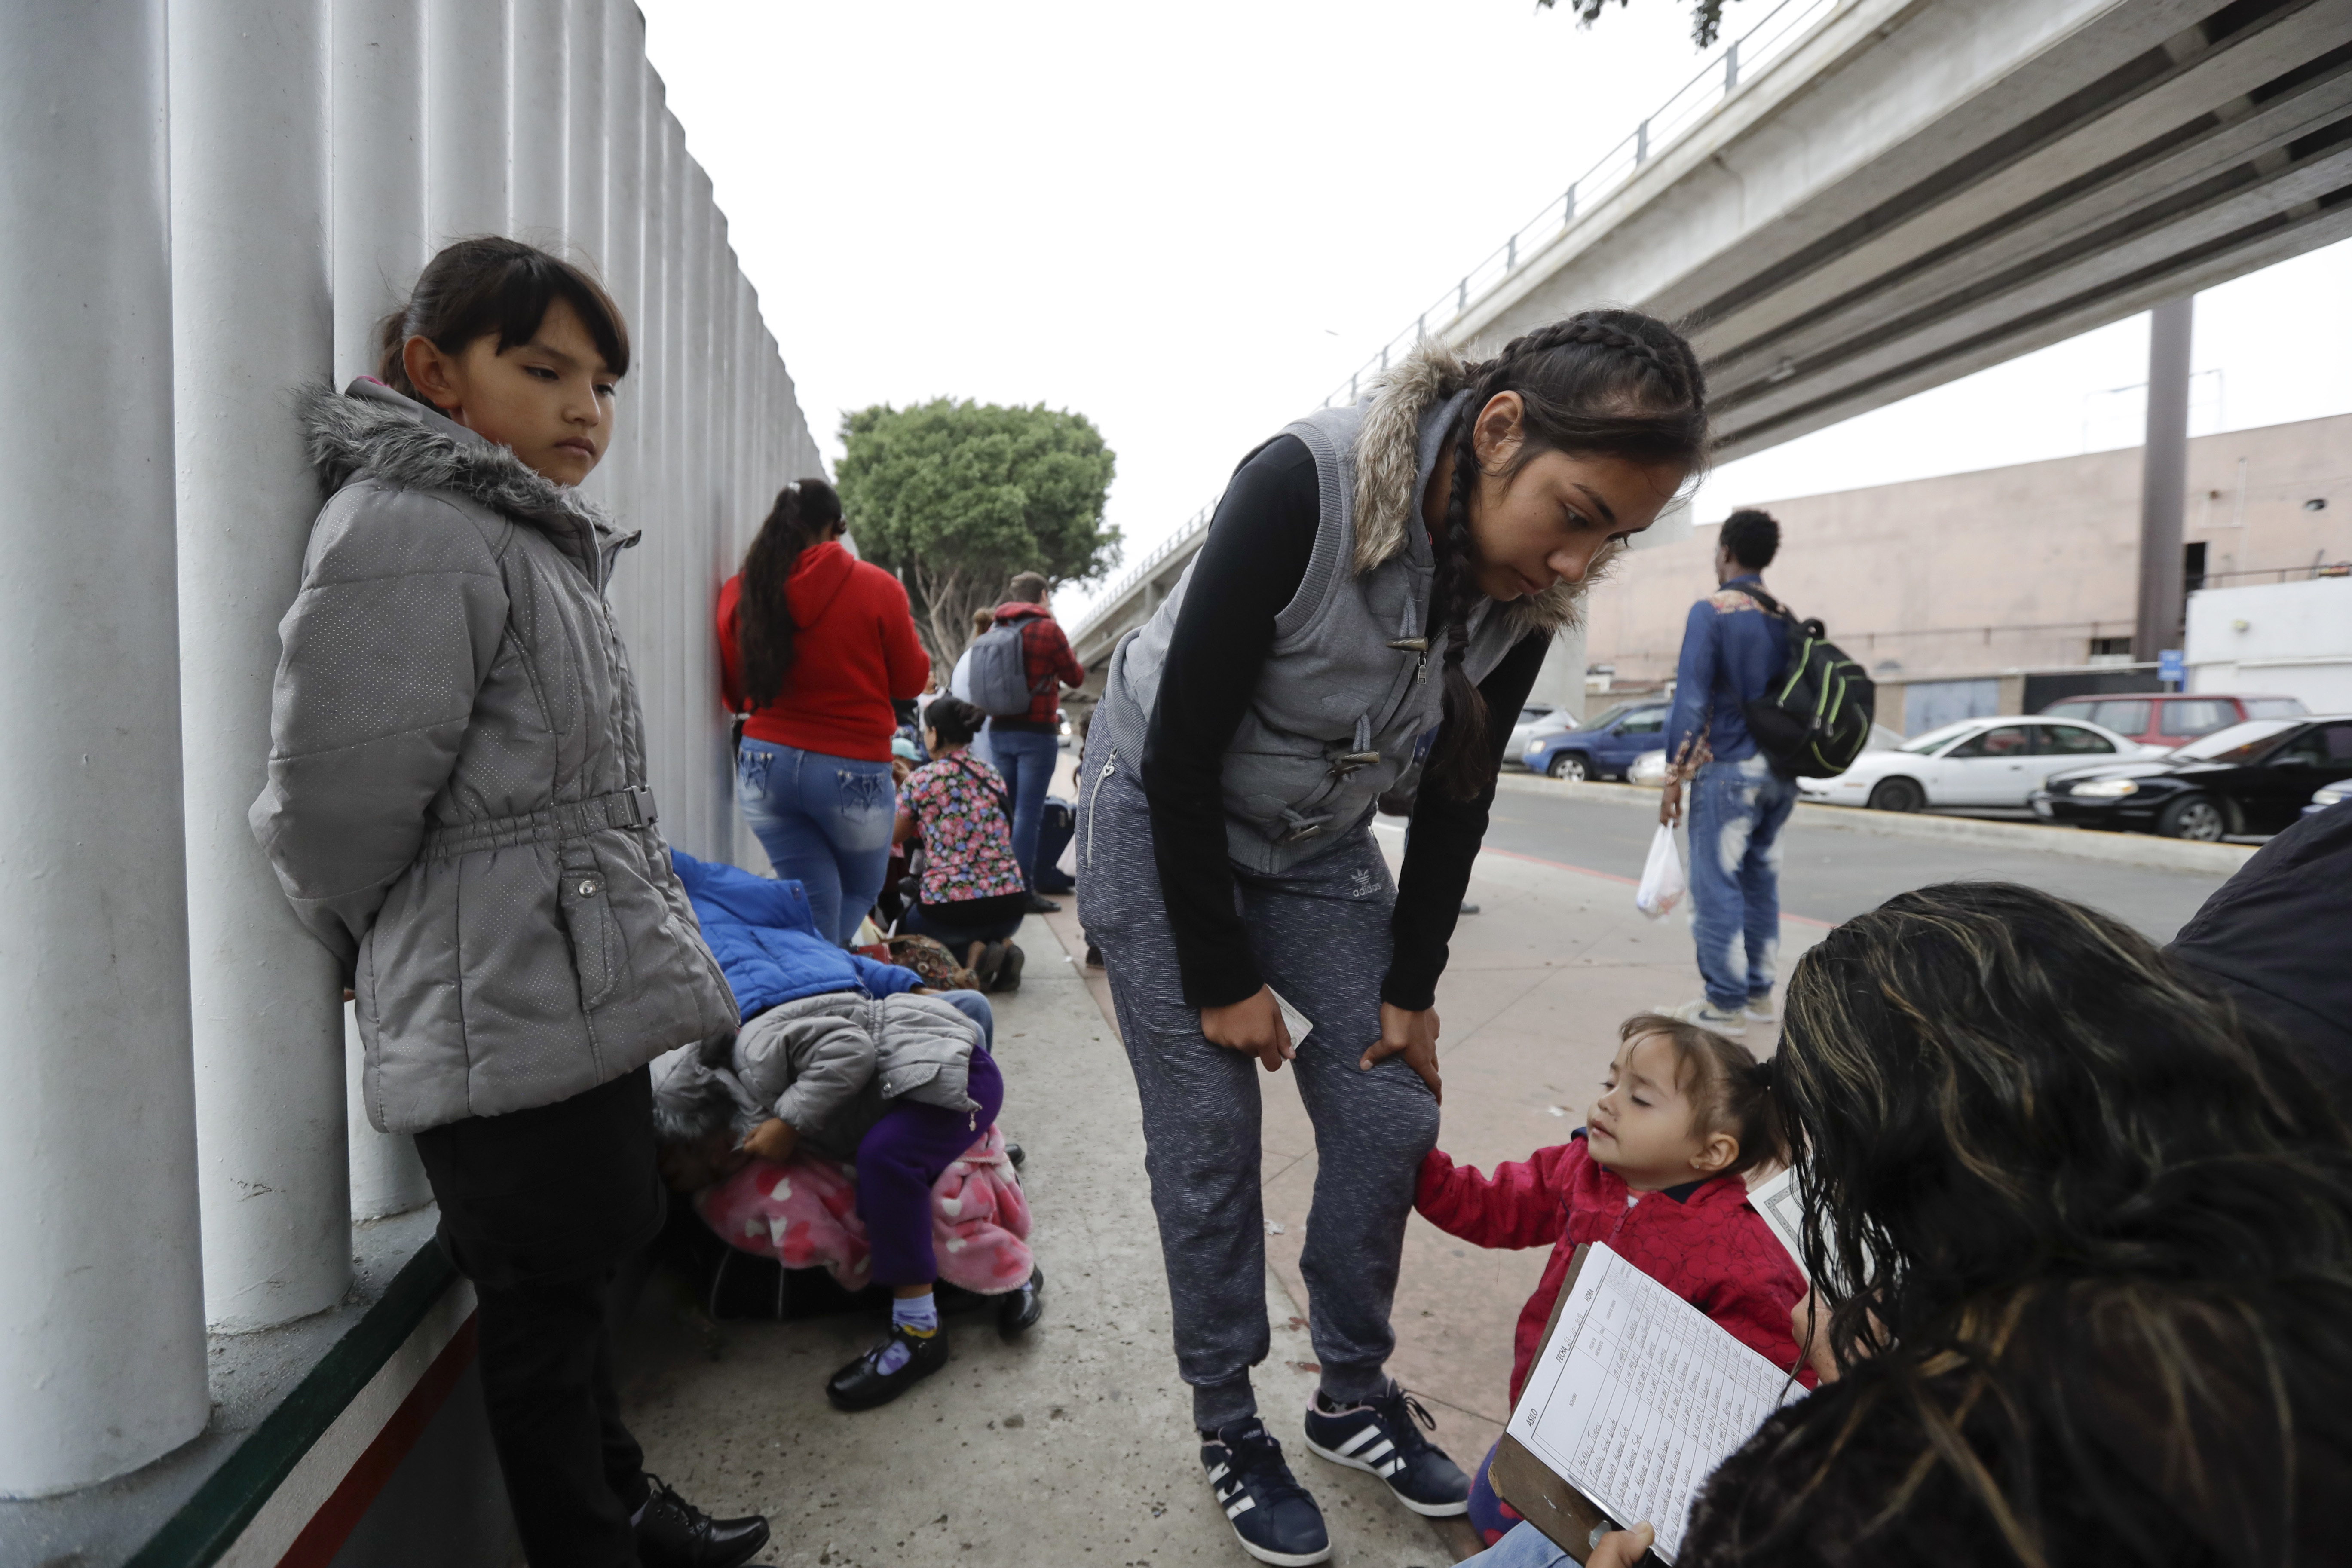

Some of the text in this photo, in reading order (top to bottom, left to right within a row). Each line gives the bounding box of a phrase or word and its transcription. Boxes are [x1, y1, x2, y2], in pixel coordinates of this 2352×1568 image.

[1353, 882, 1381, 897] adidas
[1526, 1408, 1537, 1427] ASILO
[1556, 1345, 1567, 1363] FECHA
[1584, 1288, 1594, 1302] HORA
[1569, 1392, 1577, 1406] NOMBRE
